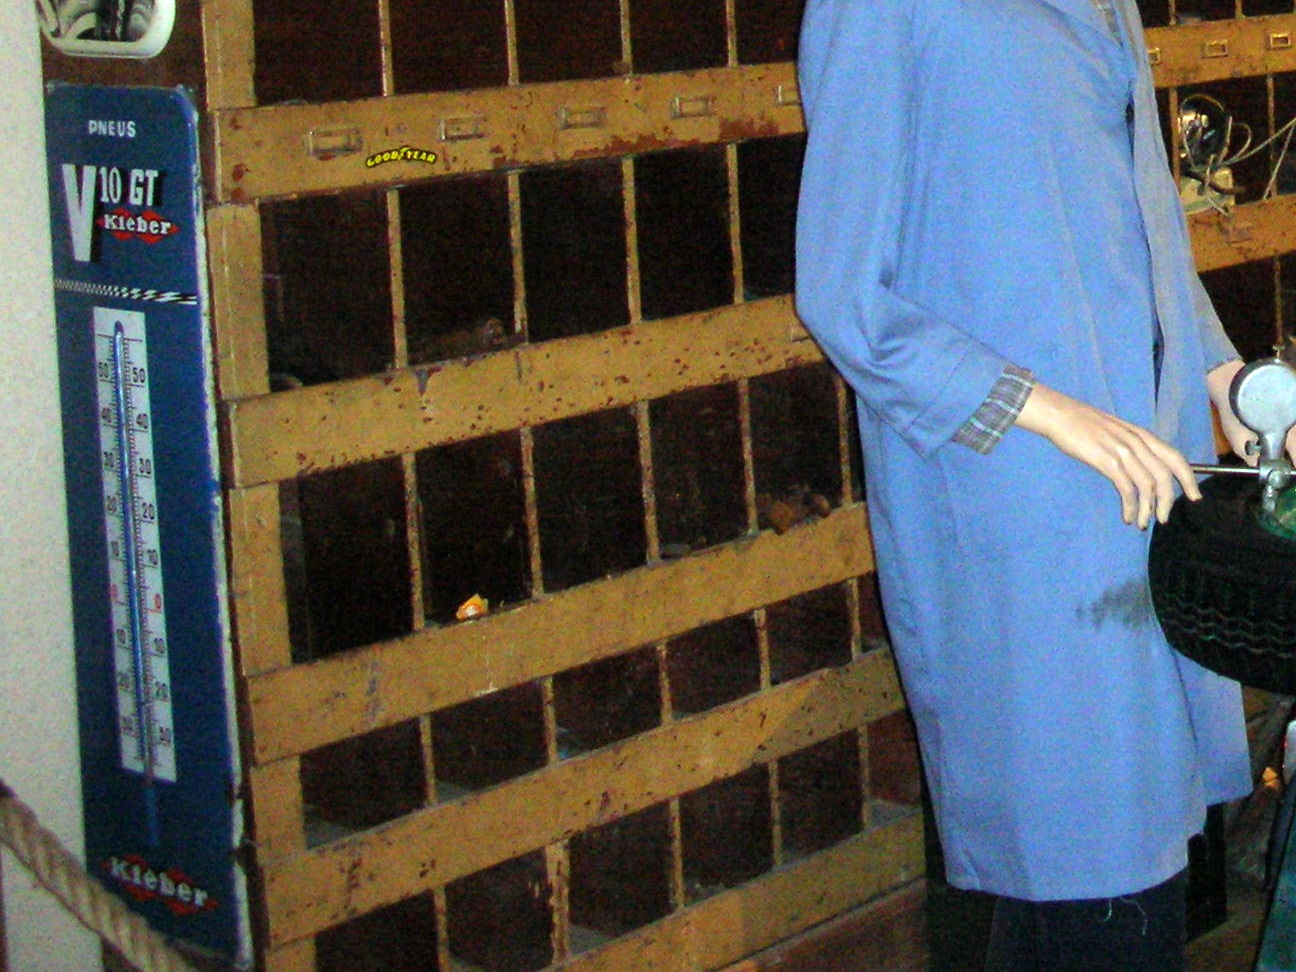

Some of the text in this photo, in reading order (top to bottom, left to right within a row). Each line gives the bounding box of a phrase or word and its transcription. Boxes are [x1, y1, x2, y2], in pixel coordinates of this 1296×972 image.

[88, 119, 137, 138] PNEUS
[366, 146, 436, 167] GOODYEAR
[129, 168, 159, 207] GT
[104, 212, 172, 236] Kleber
[132, 367, 146, 384] 50
[139, 458, 151, 475] 30
[141, 503, 156, 521] 20
[154, 593, 163, 610] 0
[110, 856, 209, 907] Kleber
